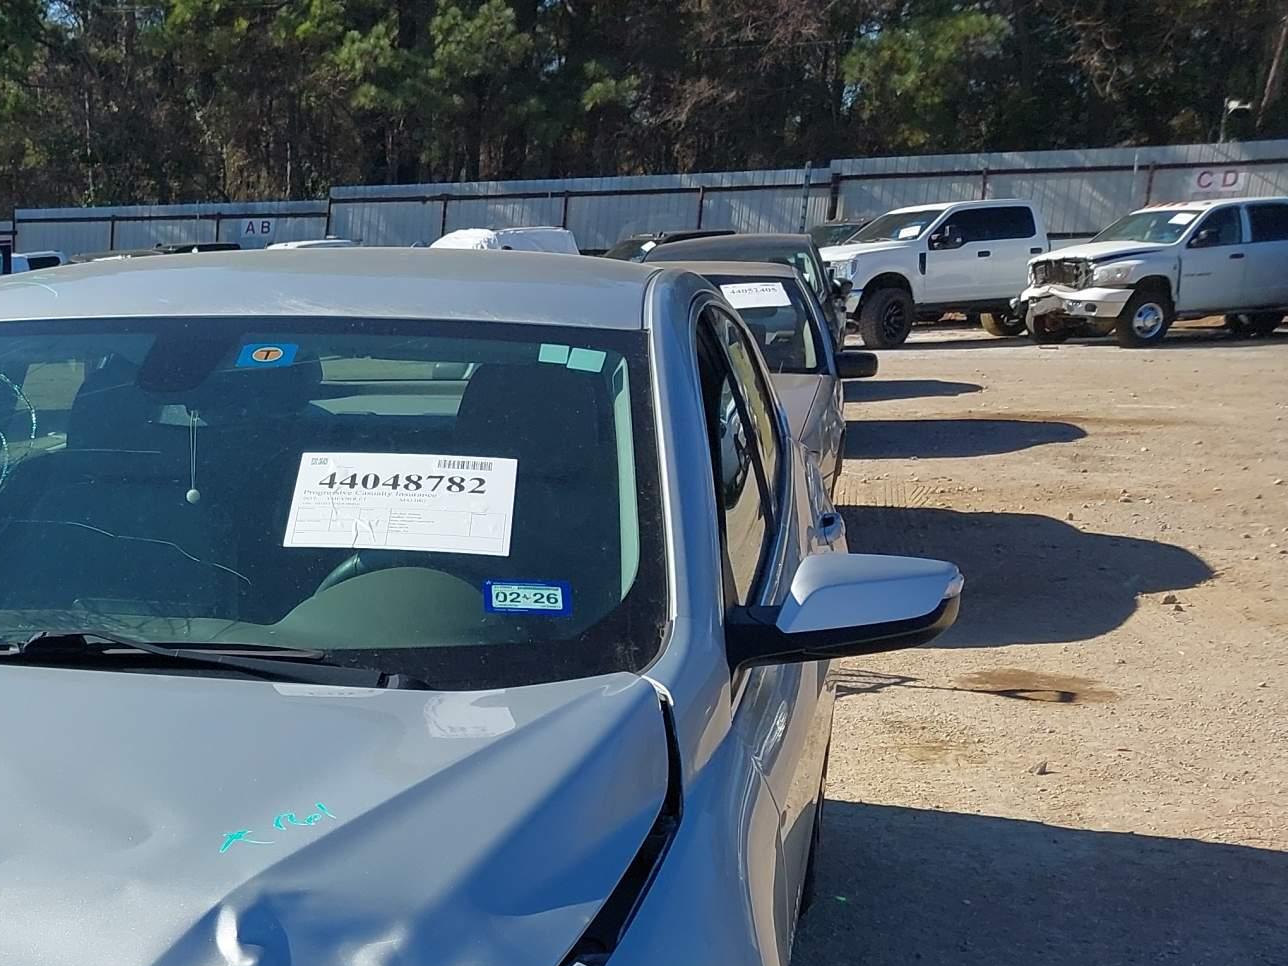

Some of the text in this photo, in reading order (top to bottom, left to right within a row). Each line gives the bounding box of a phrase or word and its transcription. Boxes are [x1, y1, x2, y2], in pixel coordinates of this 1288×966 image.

[318, 471, 487, 495] 44048782
[495, 591, 559, 605] 02 26
